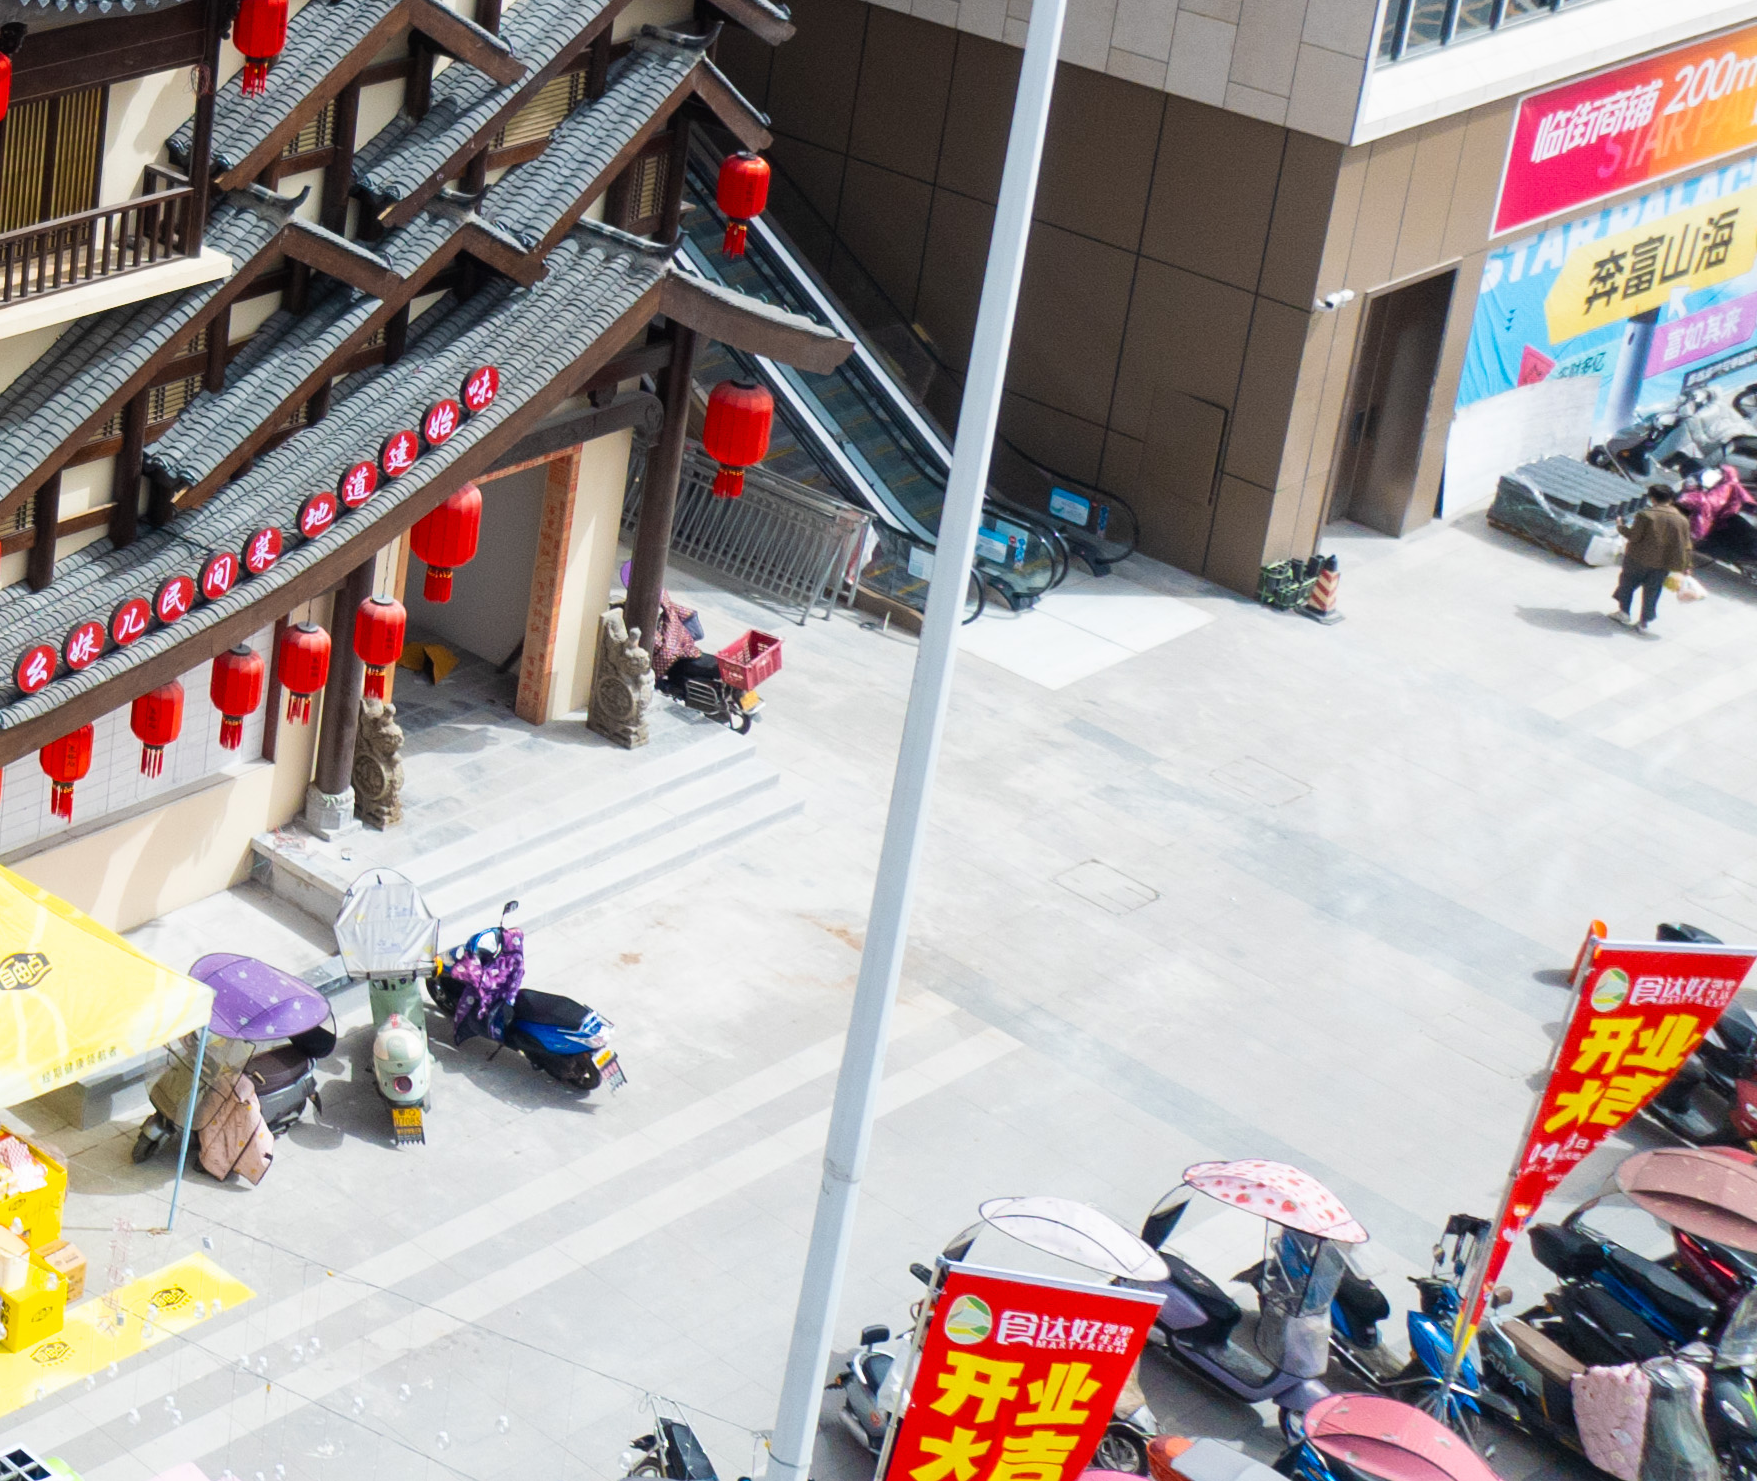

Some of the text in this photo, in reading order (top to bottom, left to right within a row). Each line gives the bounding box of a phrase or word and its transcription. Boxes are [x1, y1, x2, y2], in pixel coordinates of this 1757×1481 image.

[1531, 79, 1663, 163] 临街商铺
[1583, 208, 1739, 315] 奔富山海
[1664, 308, 1742, 362] 富如其来
[1629, 976, 1707, 1005] 食达好
[1570, 1014, 1701, 1076] 开业
[996, 1310, 1102, 1346] 食达好
[929, 1351, 1102, 1425] 开业
[908, 1426, 1081, 1481] 大吉
